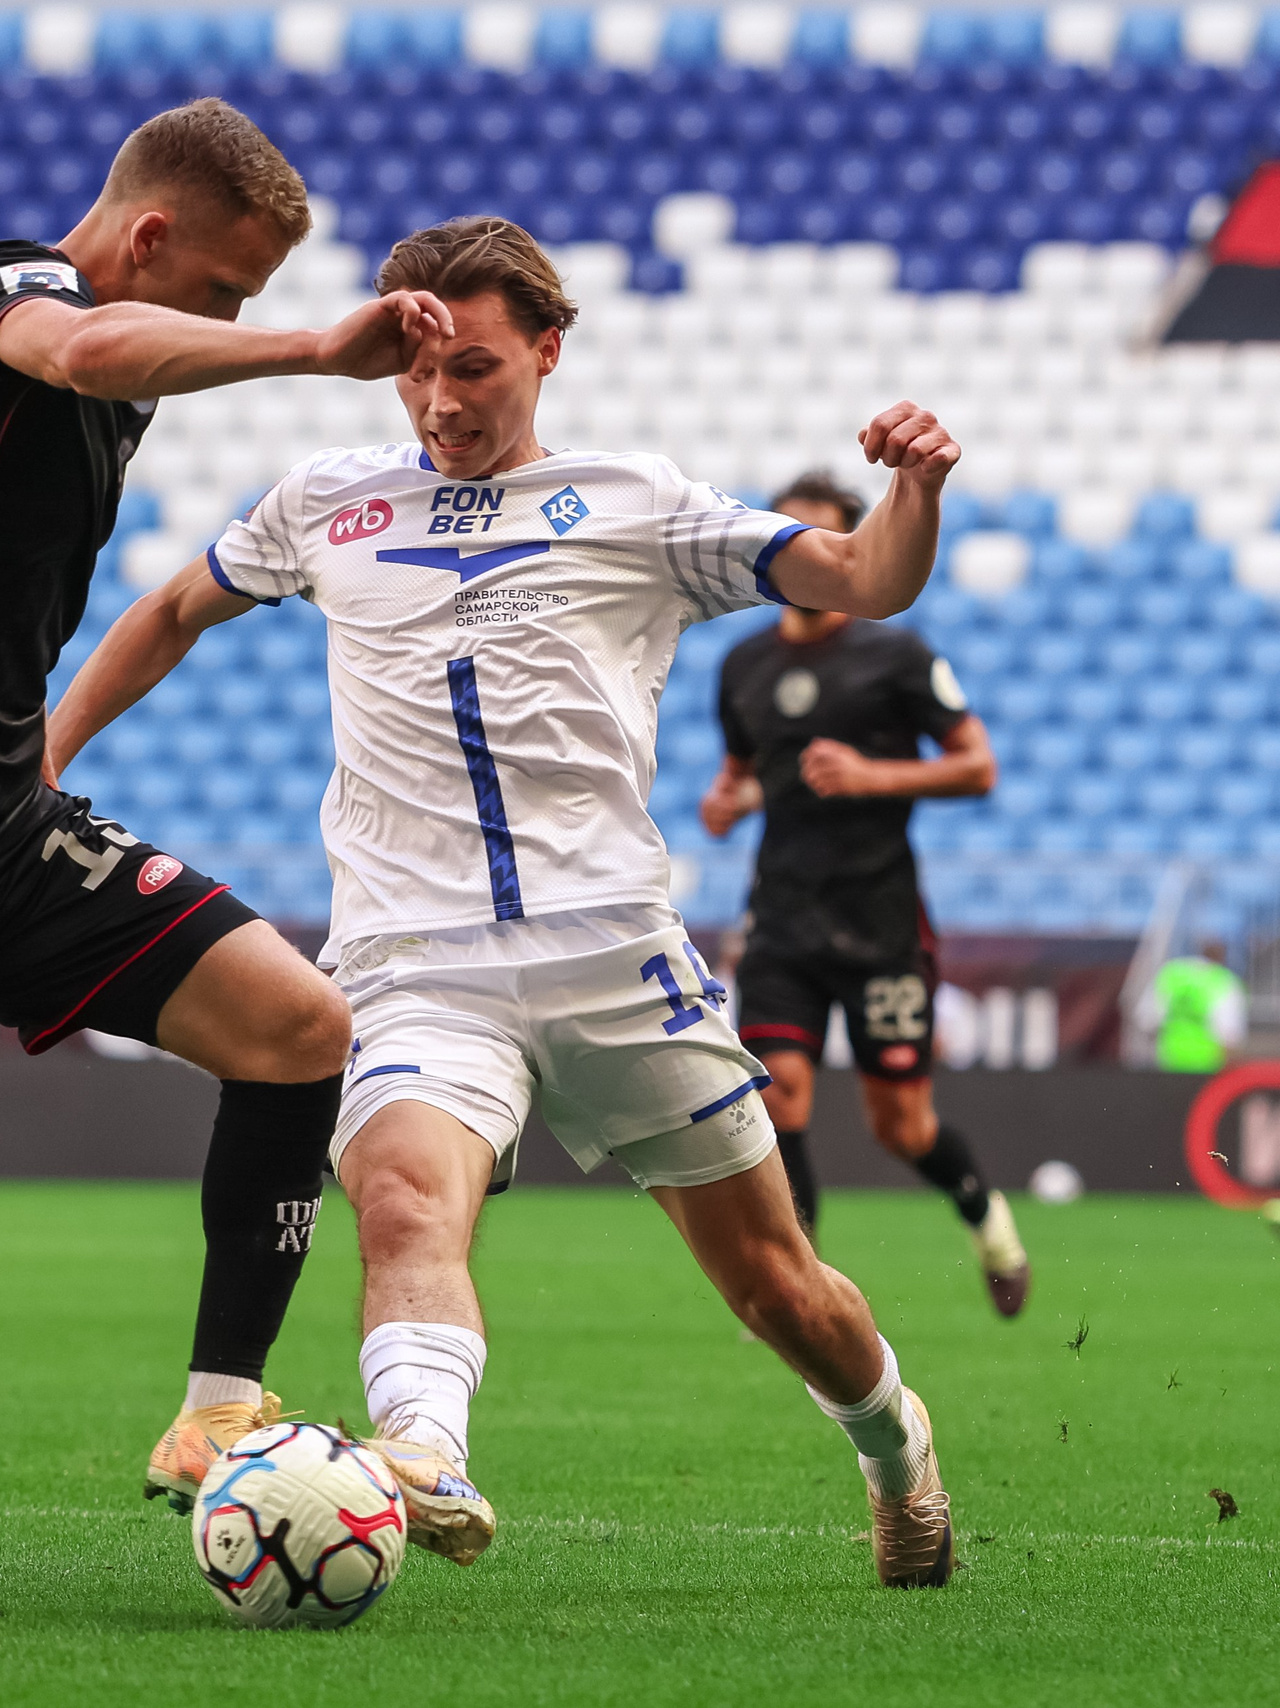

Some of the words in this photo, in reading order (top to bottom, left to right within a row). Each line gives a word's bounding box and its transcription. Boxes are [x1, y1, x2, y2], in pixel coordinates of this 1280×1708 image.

[430, 486, 505, 511] FON
[427, 512, 503, 535] BET
[454, 589, 569, 606] ПРАВИТЕЛЬСТВО
[455, 601, 539, 615] САМАРСКОЙ
[455, 613, 519, 627] ОБЛАСТИ
[144, 857, 178, 887] RIFAR
[865, 976, 928, 1041] 22
[727, 1115, 757, 1139] KELME
